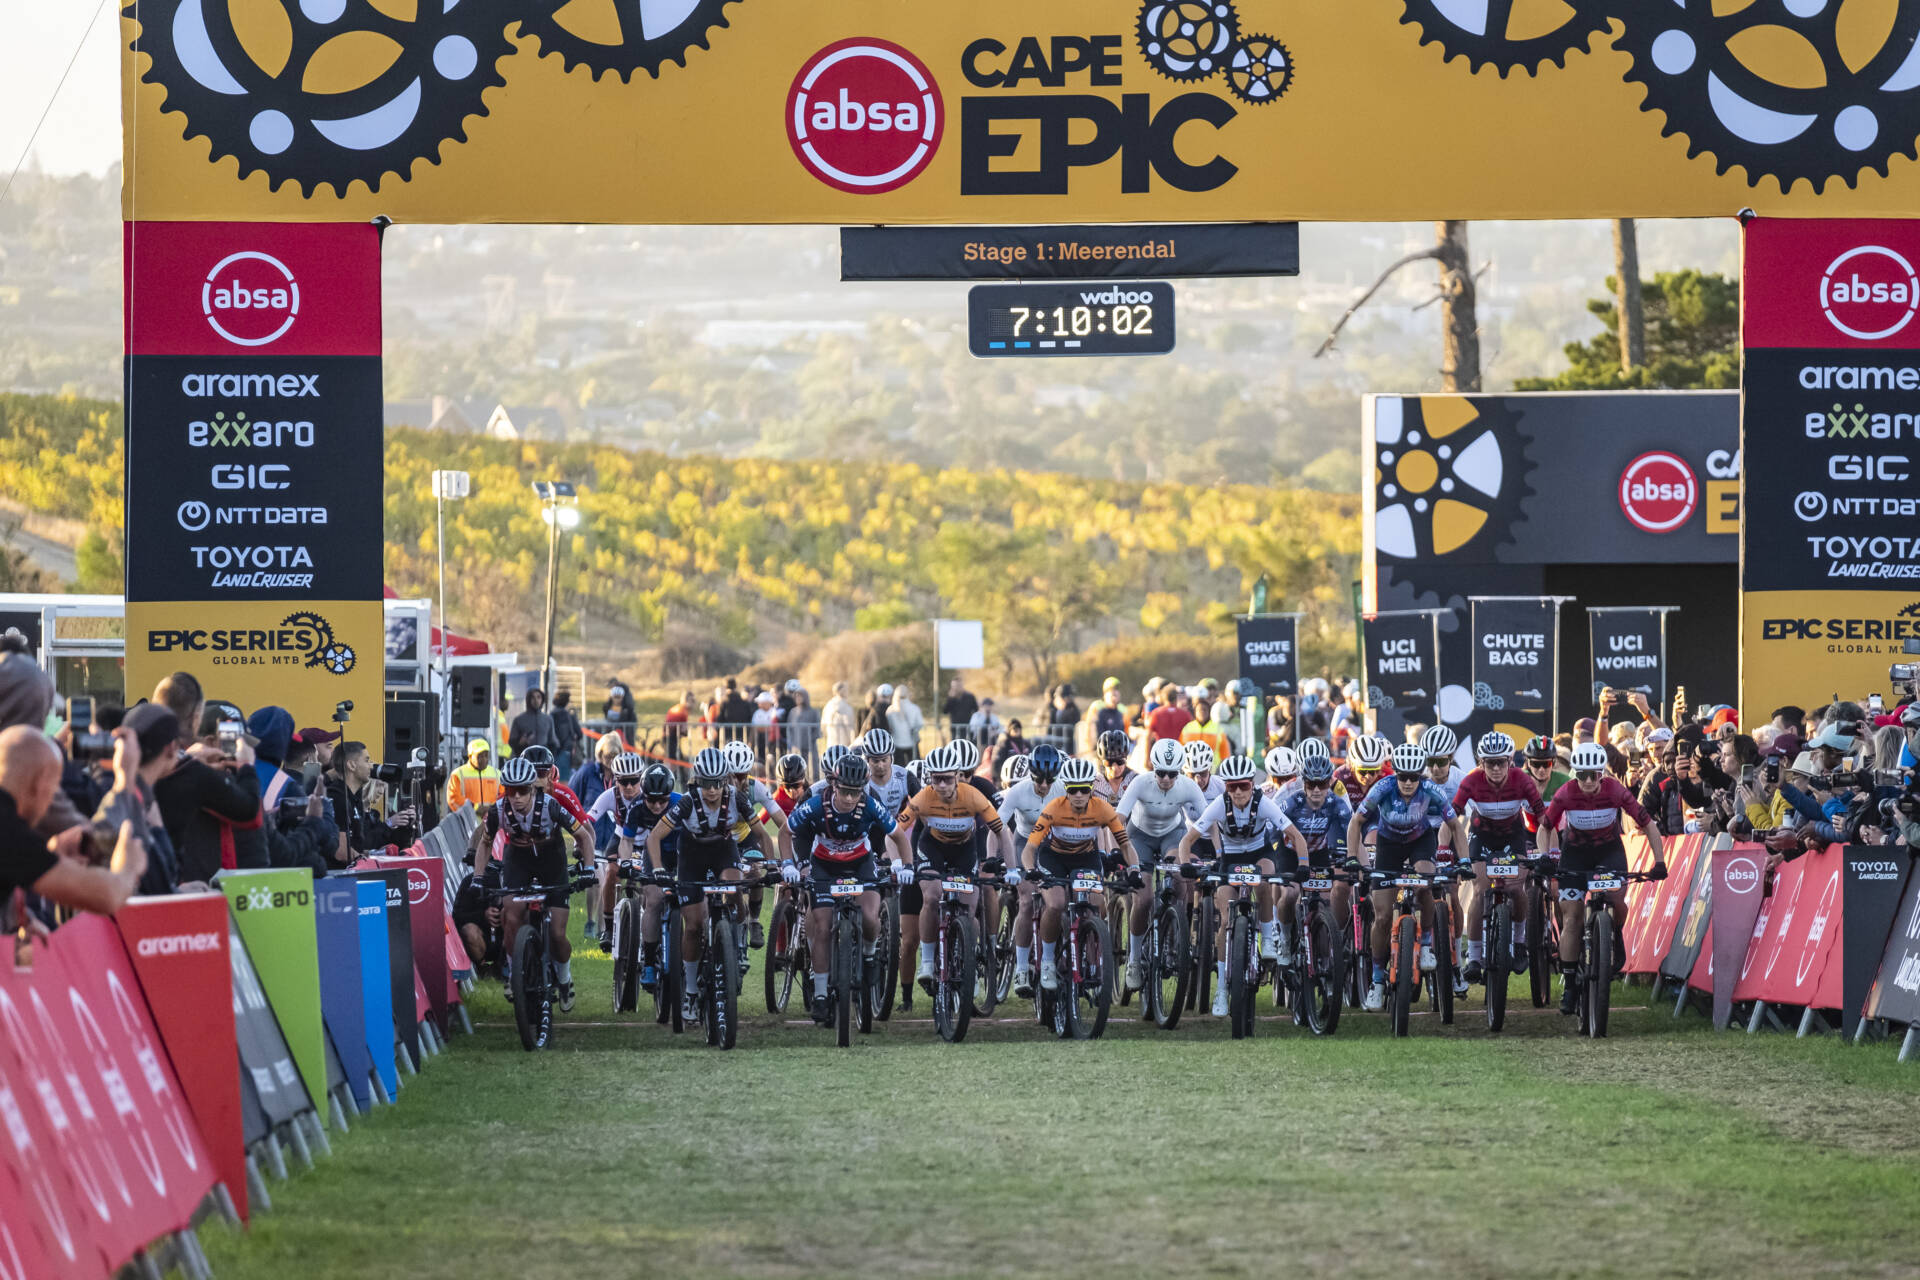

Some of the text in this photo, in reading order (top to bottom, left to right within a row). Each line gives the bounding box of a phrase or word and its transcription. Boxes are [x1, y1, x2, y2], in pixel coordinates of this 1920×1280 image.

[961, 35, 1122, 88] CAPE
[812, 87, 919, 132] absa
[960, 92, 1238, 195] EPIC
[964, 240, 1176, 264] Stage 1: Meerendal
[213, 280, 288, 309] absa
[1080, 286, 1153, 305] wahoo
[1831, 273, 1908, 303] absa
[1010, 305, 1153, 337] 7:10:02
[182, 375, 320, 398] aramex
[1799, 366, 1920, 390] arame
[189, 411, 315, 447] exxaro
[1806, 404, 1920, 438] exxar
[211, 465, 290, 490] GIC
[1829, 455, 1910, 481] GIC
[1631, 476, 1687, 501] absa
[216, 507, 261, 523] NTT
[1833, 498, 1880, 515] NTT
[191, 546, 313, 568] TOYOTA
[1763, 619, 1823, 640] EPIC
[149, 630, 313, 651] EPIC SERIES
[1245, 641, 1290, 653] CHUTE
[1382, 639, 1416, 655] UCI
[1483, 634, 1545, 649] CHUTE
[1609, 635, 1643, 651] UCI
[1827, 644, 1882, 654] GLOBAL
[213, 656, 300, 665] GLOBAL MTB
[1249, 653, 1287, 666] BAGS
[1378, 657, 1422, 673] MEN
[1488, 651, 1539, 665] BAGS
[1596, 655, 1658, 670] WOMEN
[1493, 866, 1512, 874] 62-1
[1728, 868, 1755, 881] absa
[1850, 862, 1899, 872] TOYOTA
[408, 878, 426, 889] bsa
[950, 882, 966, 890] 51-1
[1079, 880, 1098, 889] 51-2
[1594, 881, 1616, 889] 62-2
[236, 886, 309, 912] exxaro
[138, 932, 220, 957] aramex
